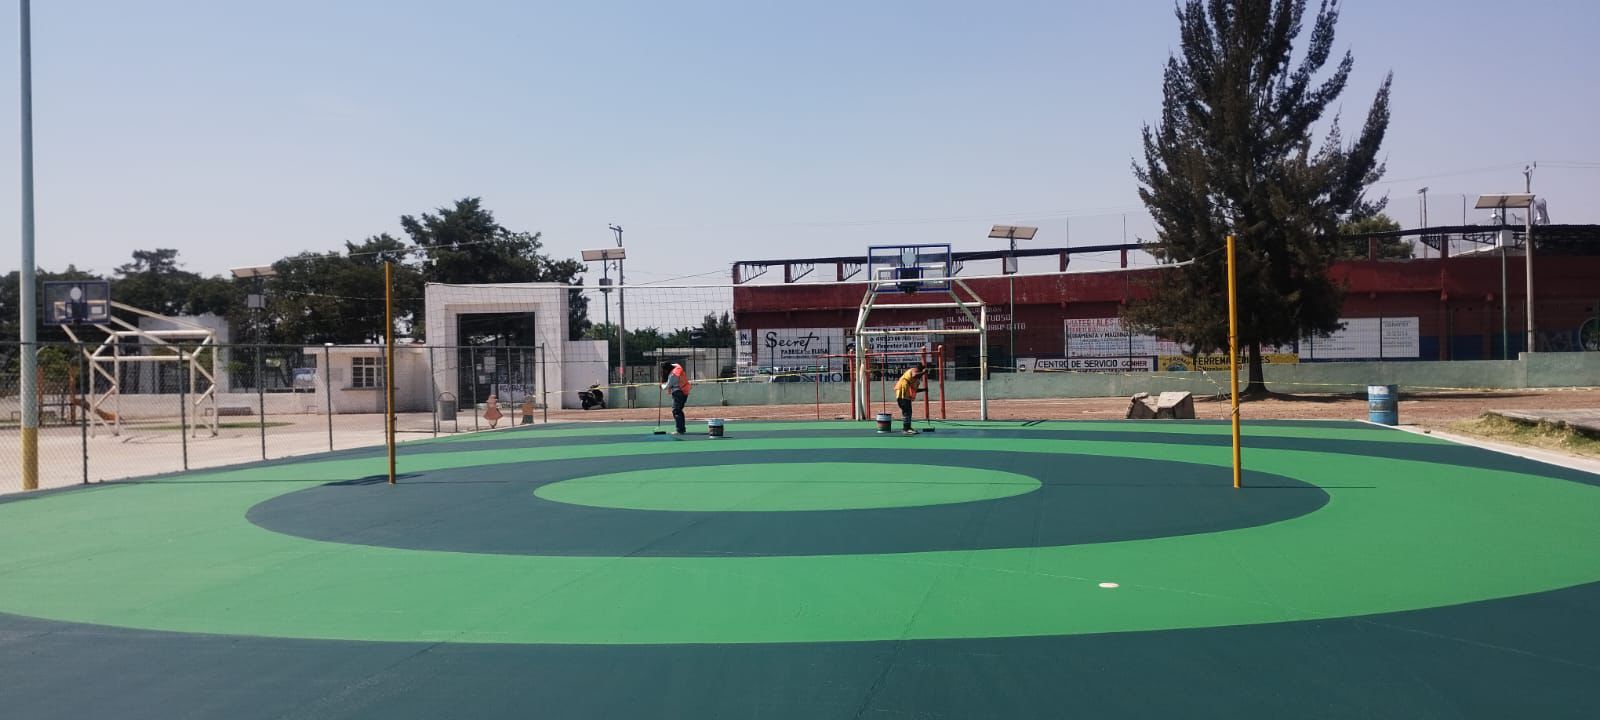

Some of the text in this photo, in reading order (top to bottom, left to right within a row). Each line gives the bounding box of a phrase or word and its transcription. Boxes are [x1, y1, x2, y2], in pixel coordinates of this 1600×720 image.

[766, 331, 820, 350] Secret
[1038, 360, 1068, 368] CENTRO
[1072, 360, 1080, 368] DE
[1084, 359, 1118, 368] SERVICIO
